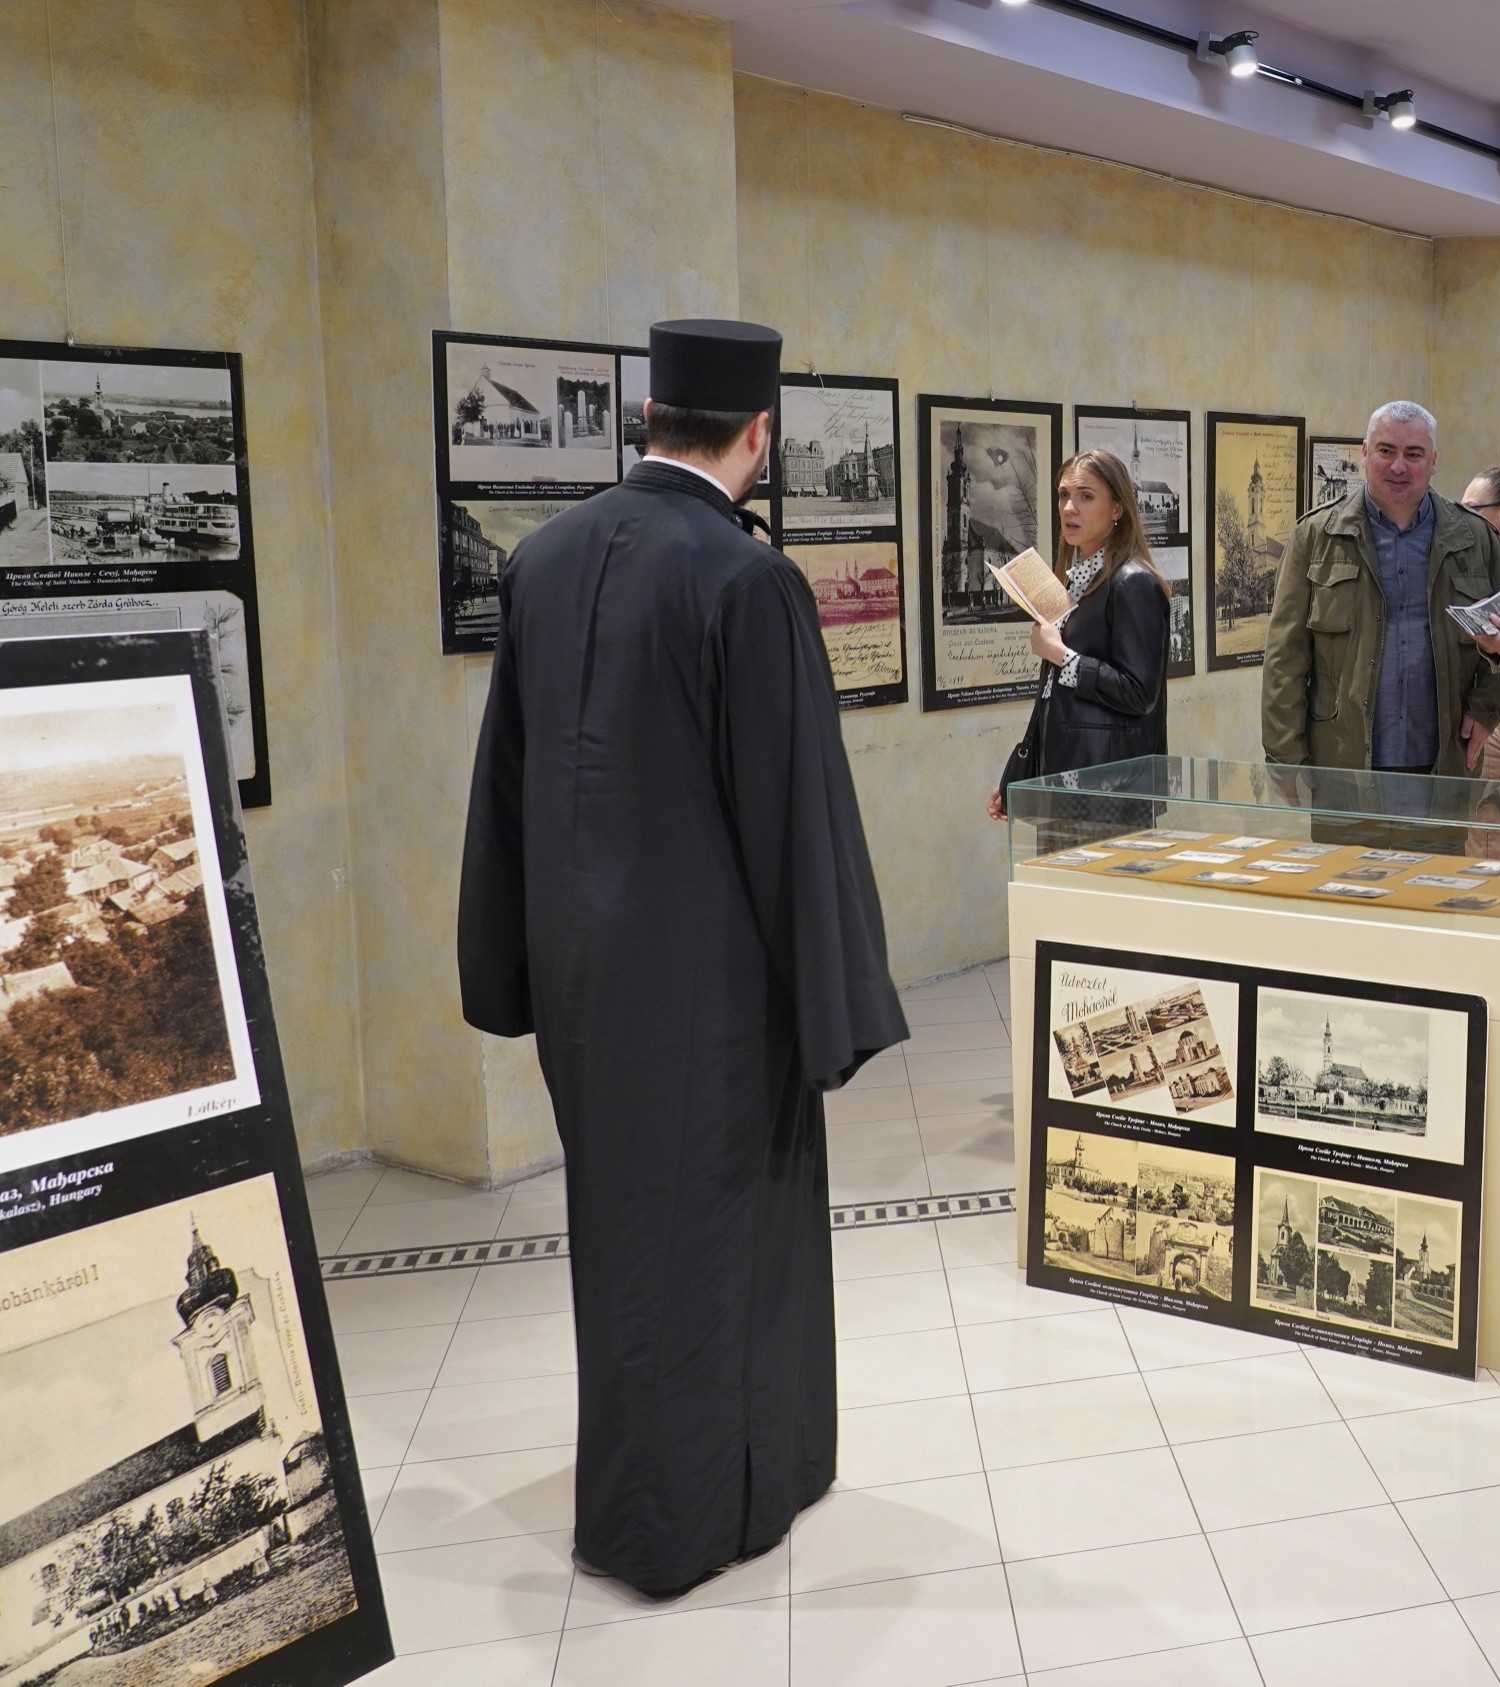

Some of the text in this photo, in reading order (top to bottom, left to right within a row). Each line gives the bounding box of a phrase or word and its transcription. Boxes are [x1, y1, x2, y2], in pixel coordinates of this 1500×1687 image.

[123, 569, 157, 577] Мађарска
[2, 602, 27, 616] Görög
[88, 599, 112, 610] Zárda
[1059, 972, 1107, 990] Üdvözlet
[1062, 986, 1118, 1022] Mohácsról
[188, 1097, 236, 1117] Látkép
[1128, 1116, 1145, 1124] Тројице
[1168, 1123, 1190, 1132] Мађарска
[1332, 1150, 1352, 1159] Тројице
[1384, 1159, 1409, 1168] Мађарска
[30, 1161, 115, 1195] Мађарска
[50, 1184, 102, 1207] Hungary
[1186, 1301, 1209, 1310] Мађарска
[1351, 1335, 1372, 1345] Георгија
[1397, 1344, 1422, 1356] Мађарска
[1385, 1349, 1400, 1357] Hungary
